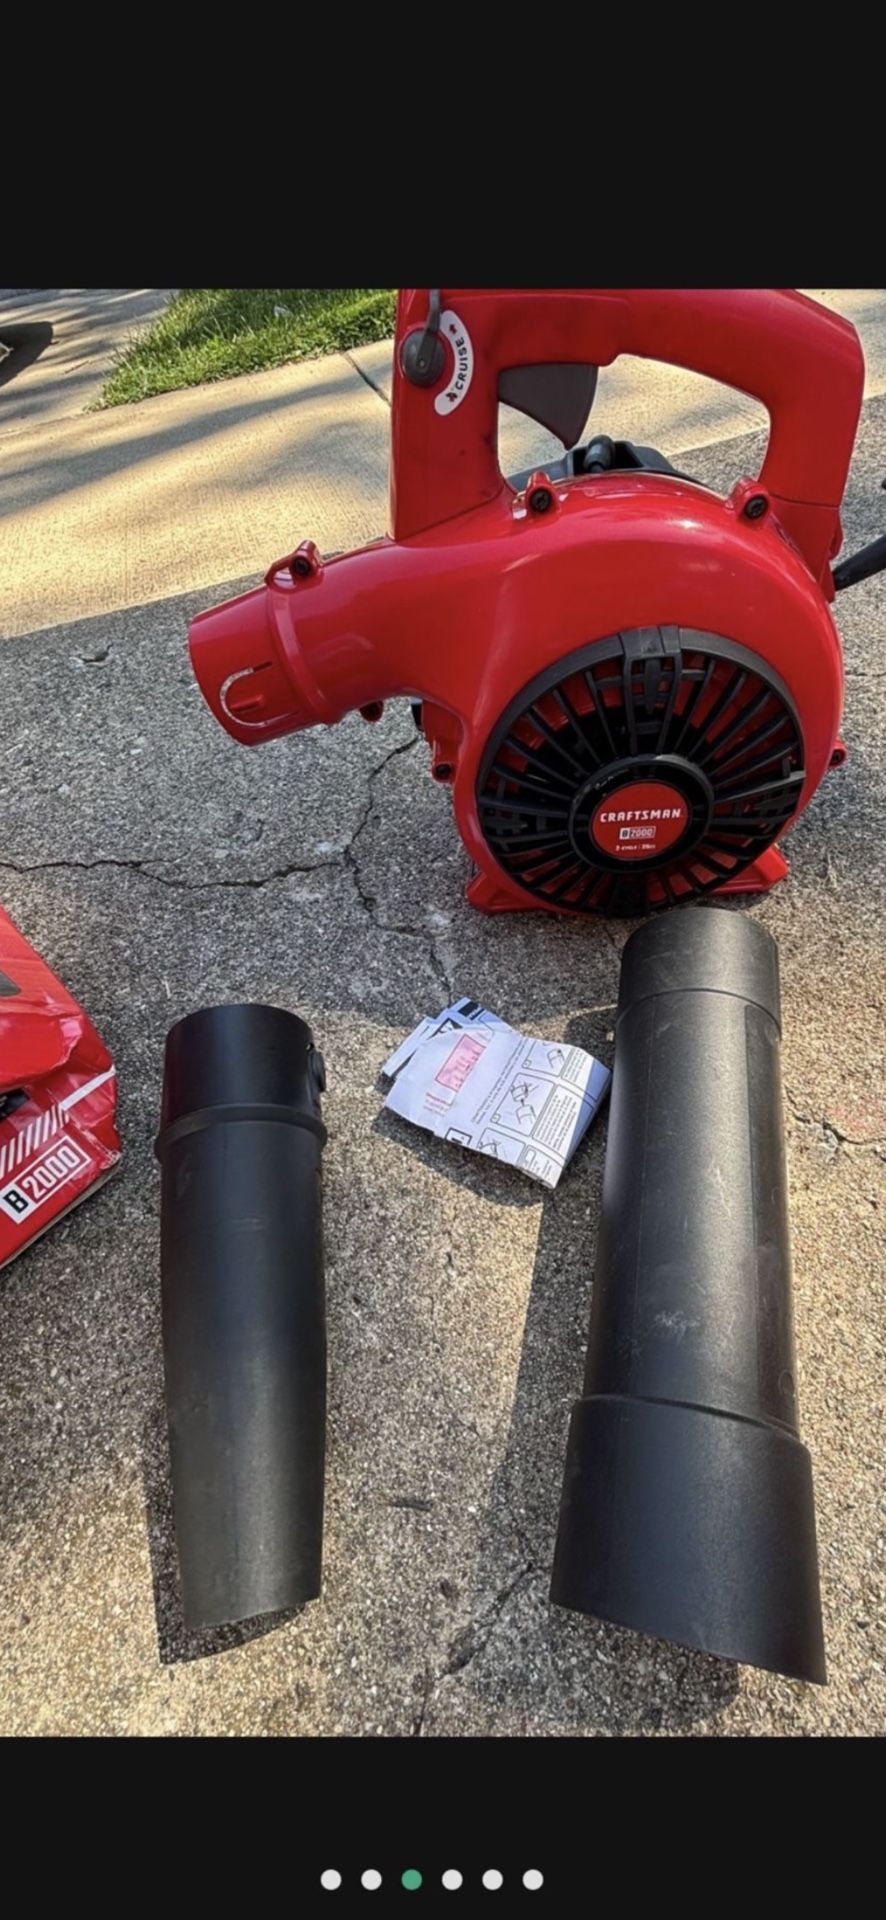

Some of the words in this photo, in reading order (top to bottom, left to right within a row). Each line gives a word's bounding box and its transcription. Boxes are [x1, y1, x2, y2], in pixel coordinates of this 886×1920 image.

[455, 337, 468, 390] CRUISE
[600, 808, 681, 823] CRAFTSMAN
[630, 828, 653, 837] 2000
[3, 1189, 29, 1214] B
[22, 1146, 81, 1199] 2000
